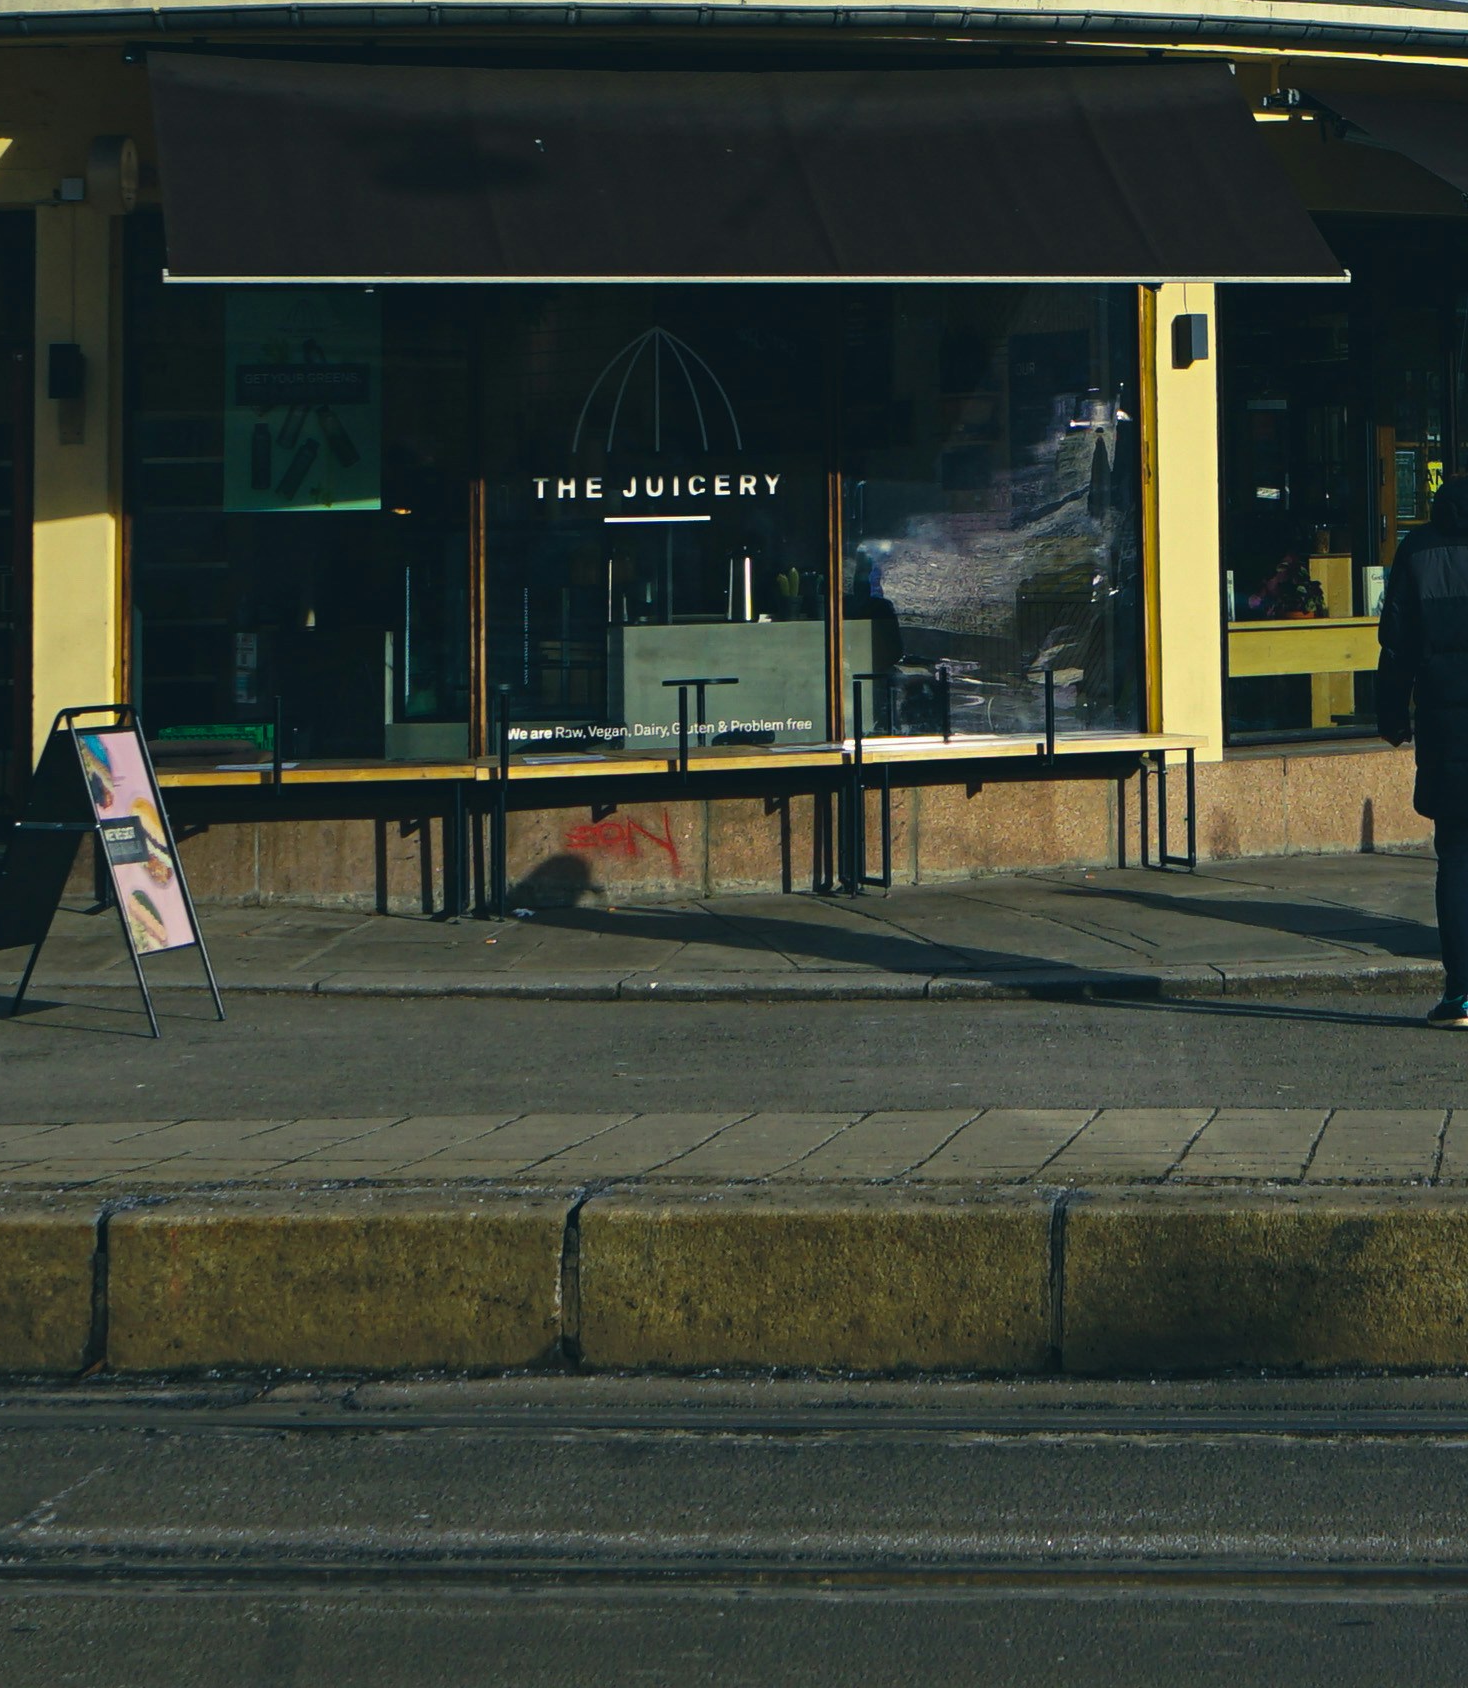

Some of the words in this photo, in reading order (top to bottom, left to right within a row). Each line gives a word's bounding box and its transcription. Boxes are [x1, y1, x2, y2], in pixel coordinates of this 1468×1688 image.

[243, 373, 270, 385] GET
[272, 372, 303, 384] YOUR
[533, 476, 603, 499] THE
[622, 473, 781, 499] JUICERY
[508, 725, 528, 740] We
[530, 728, 553, 741] are
[588, 723, 632, 742] Vegan,
[634, 722, 670, 739] Dairy,
[672, 721, 715, 737] Guten
[718, 721, 729, 733] &
[730, 718, 784, 734] Problem
[786, 717, 813, 731] free
